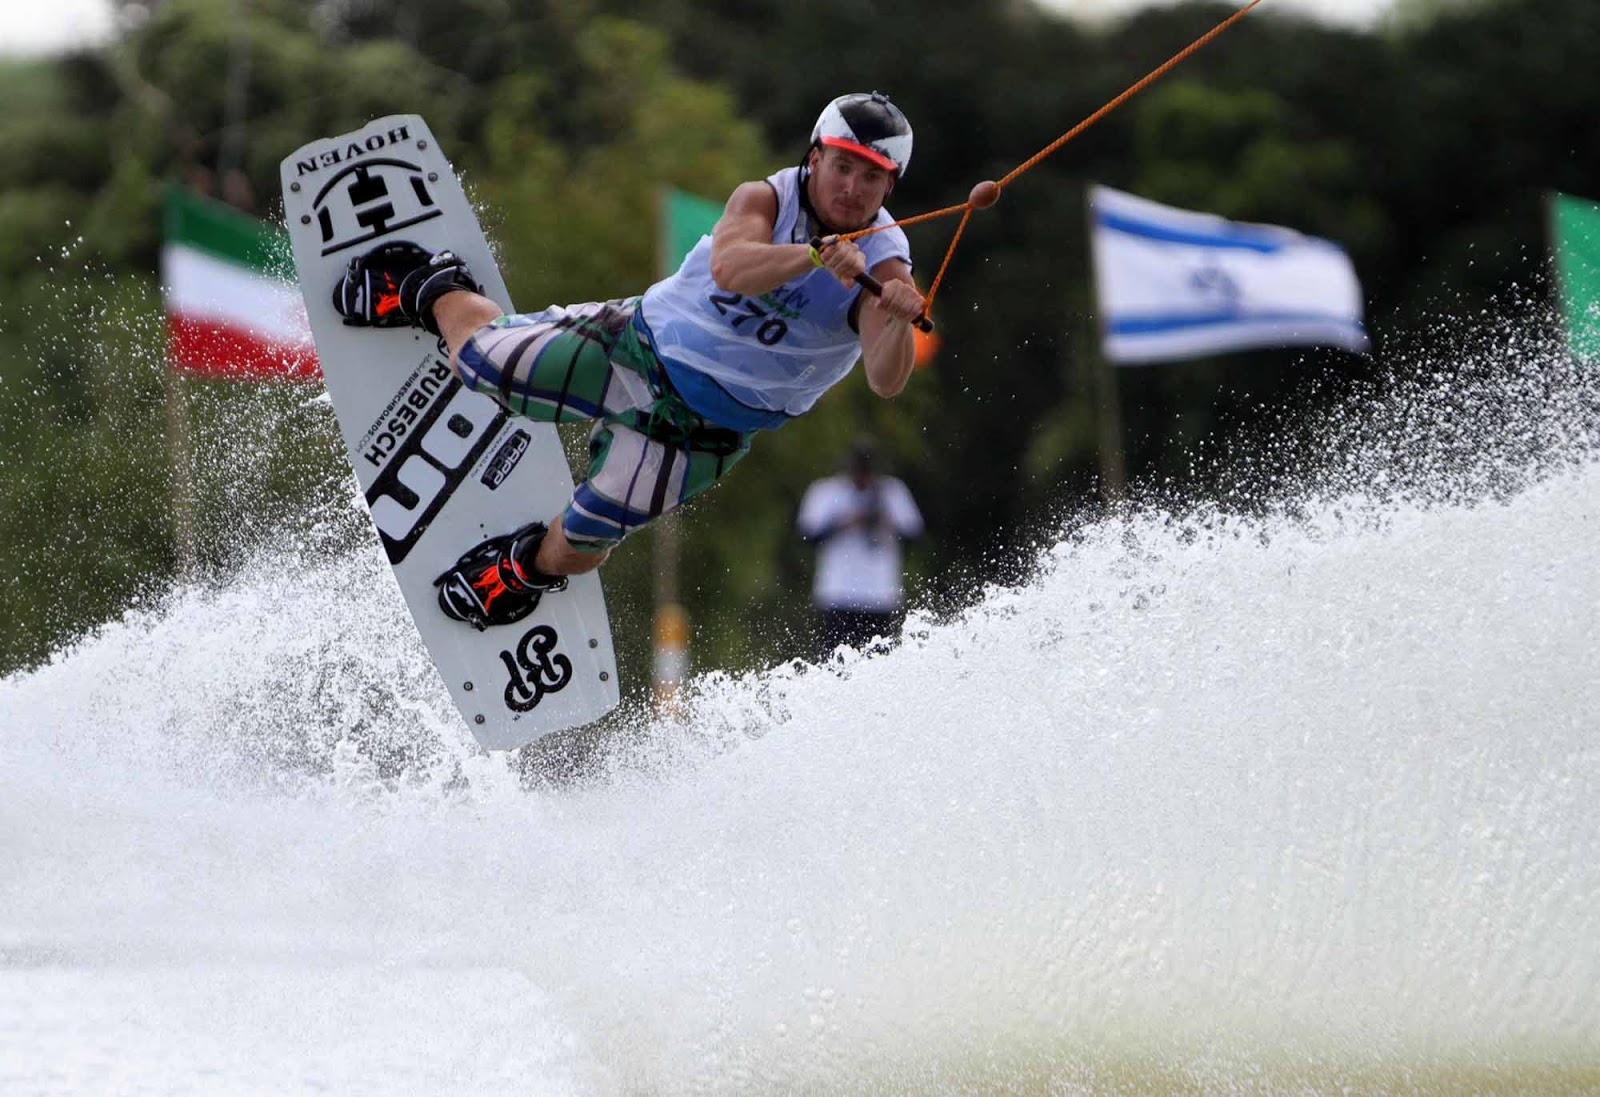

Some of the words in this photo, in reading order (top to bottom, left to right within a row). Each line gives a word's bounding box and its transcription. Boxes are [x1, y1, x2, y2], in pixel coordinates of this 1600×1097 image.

[297, 126, 410, 177] HOVEN
[709, 294, 788, 346] 270
[364, 360, 452, 467] RUBESCH
[493, 436, 530, 486] PAPP
